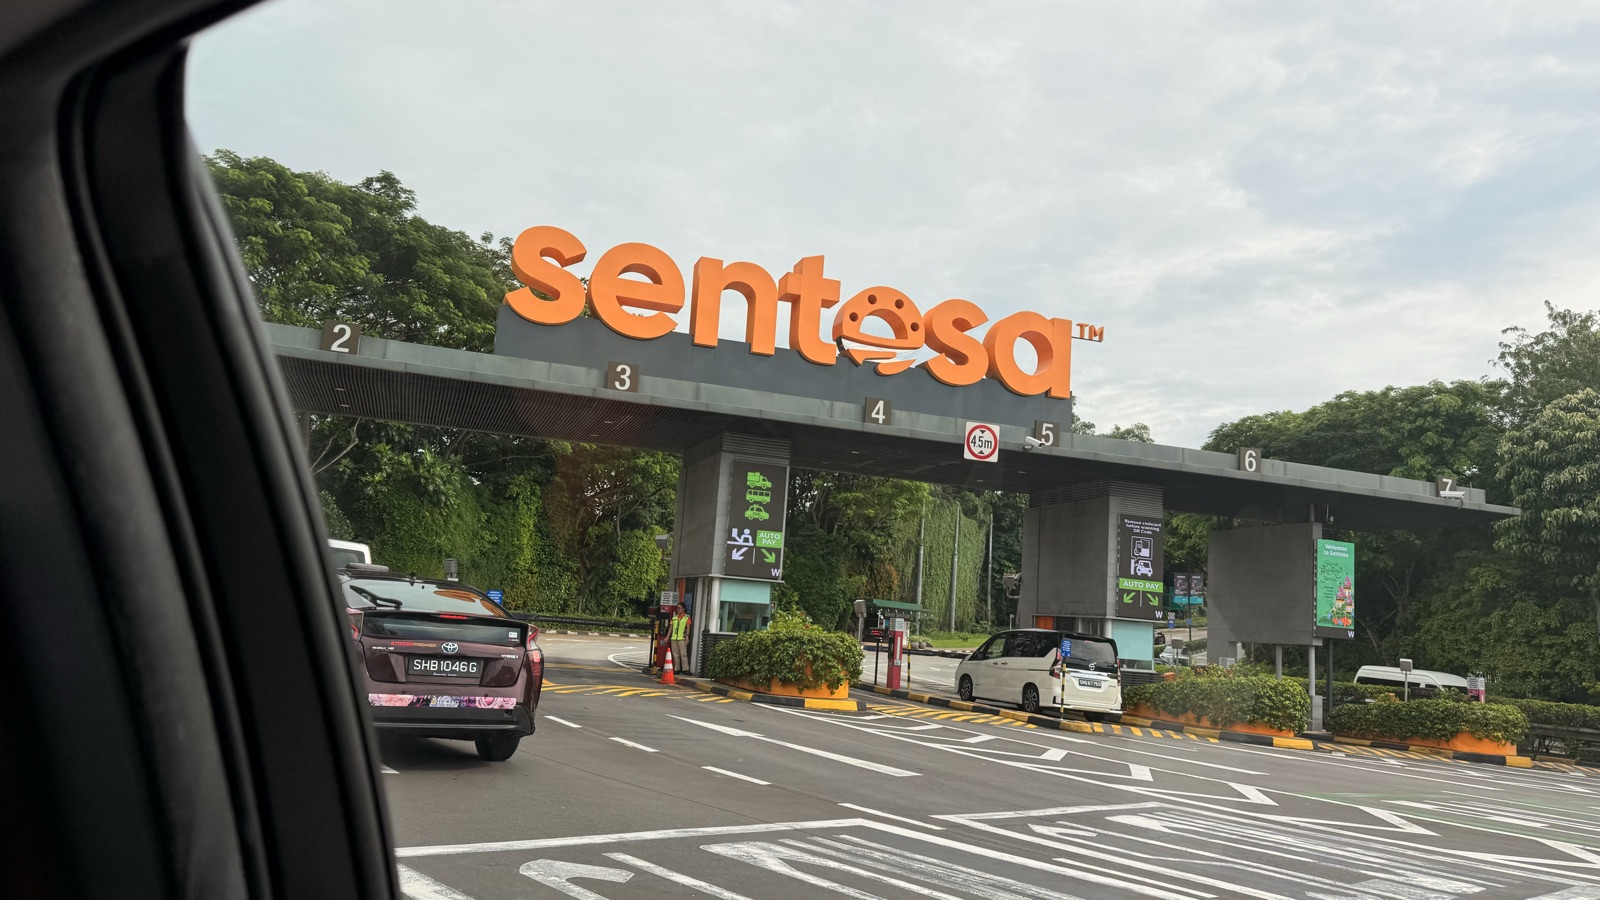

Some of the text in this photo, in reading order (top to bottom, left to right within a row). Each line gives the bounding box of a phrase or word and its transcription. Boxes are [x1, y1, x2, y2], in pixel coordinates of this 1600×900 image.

[504, 225, 1104, 399] sentosa TM
[331, 324, 351, 353] 2
[615, 364, 631, 391] 3
[871, 400, 885, 424] 4
[1040, 423, 1054, 446] 5
[971, 435, 993, 450] 4.5m
[1245, 450, 1256, 472] 6
[1442, 478, 1452, 492] 7
[759, 532, 780, 540] AUTO
[762, 538, 777, 546] PAY
[1325, 543, 1347, 552] Welcome
[1329, 550, 1349, 558] Sentosa
[771, 568, 780, 577] W
[1123, 580, 1159, 590] AUTO PAY
[1155, 610, 1163, 619] W
[1347, 630, 1354, 638] W
